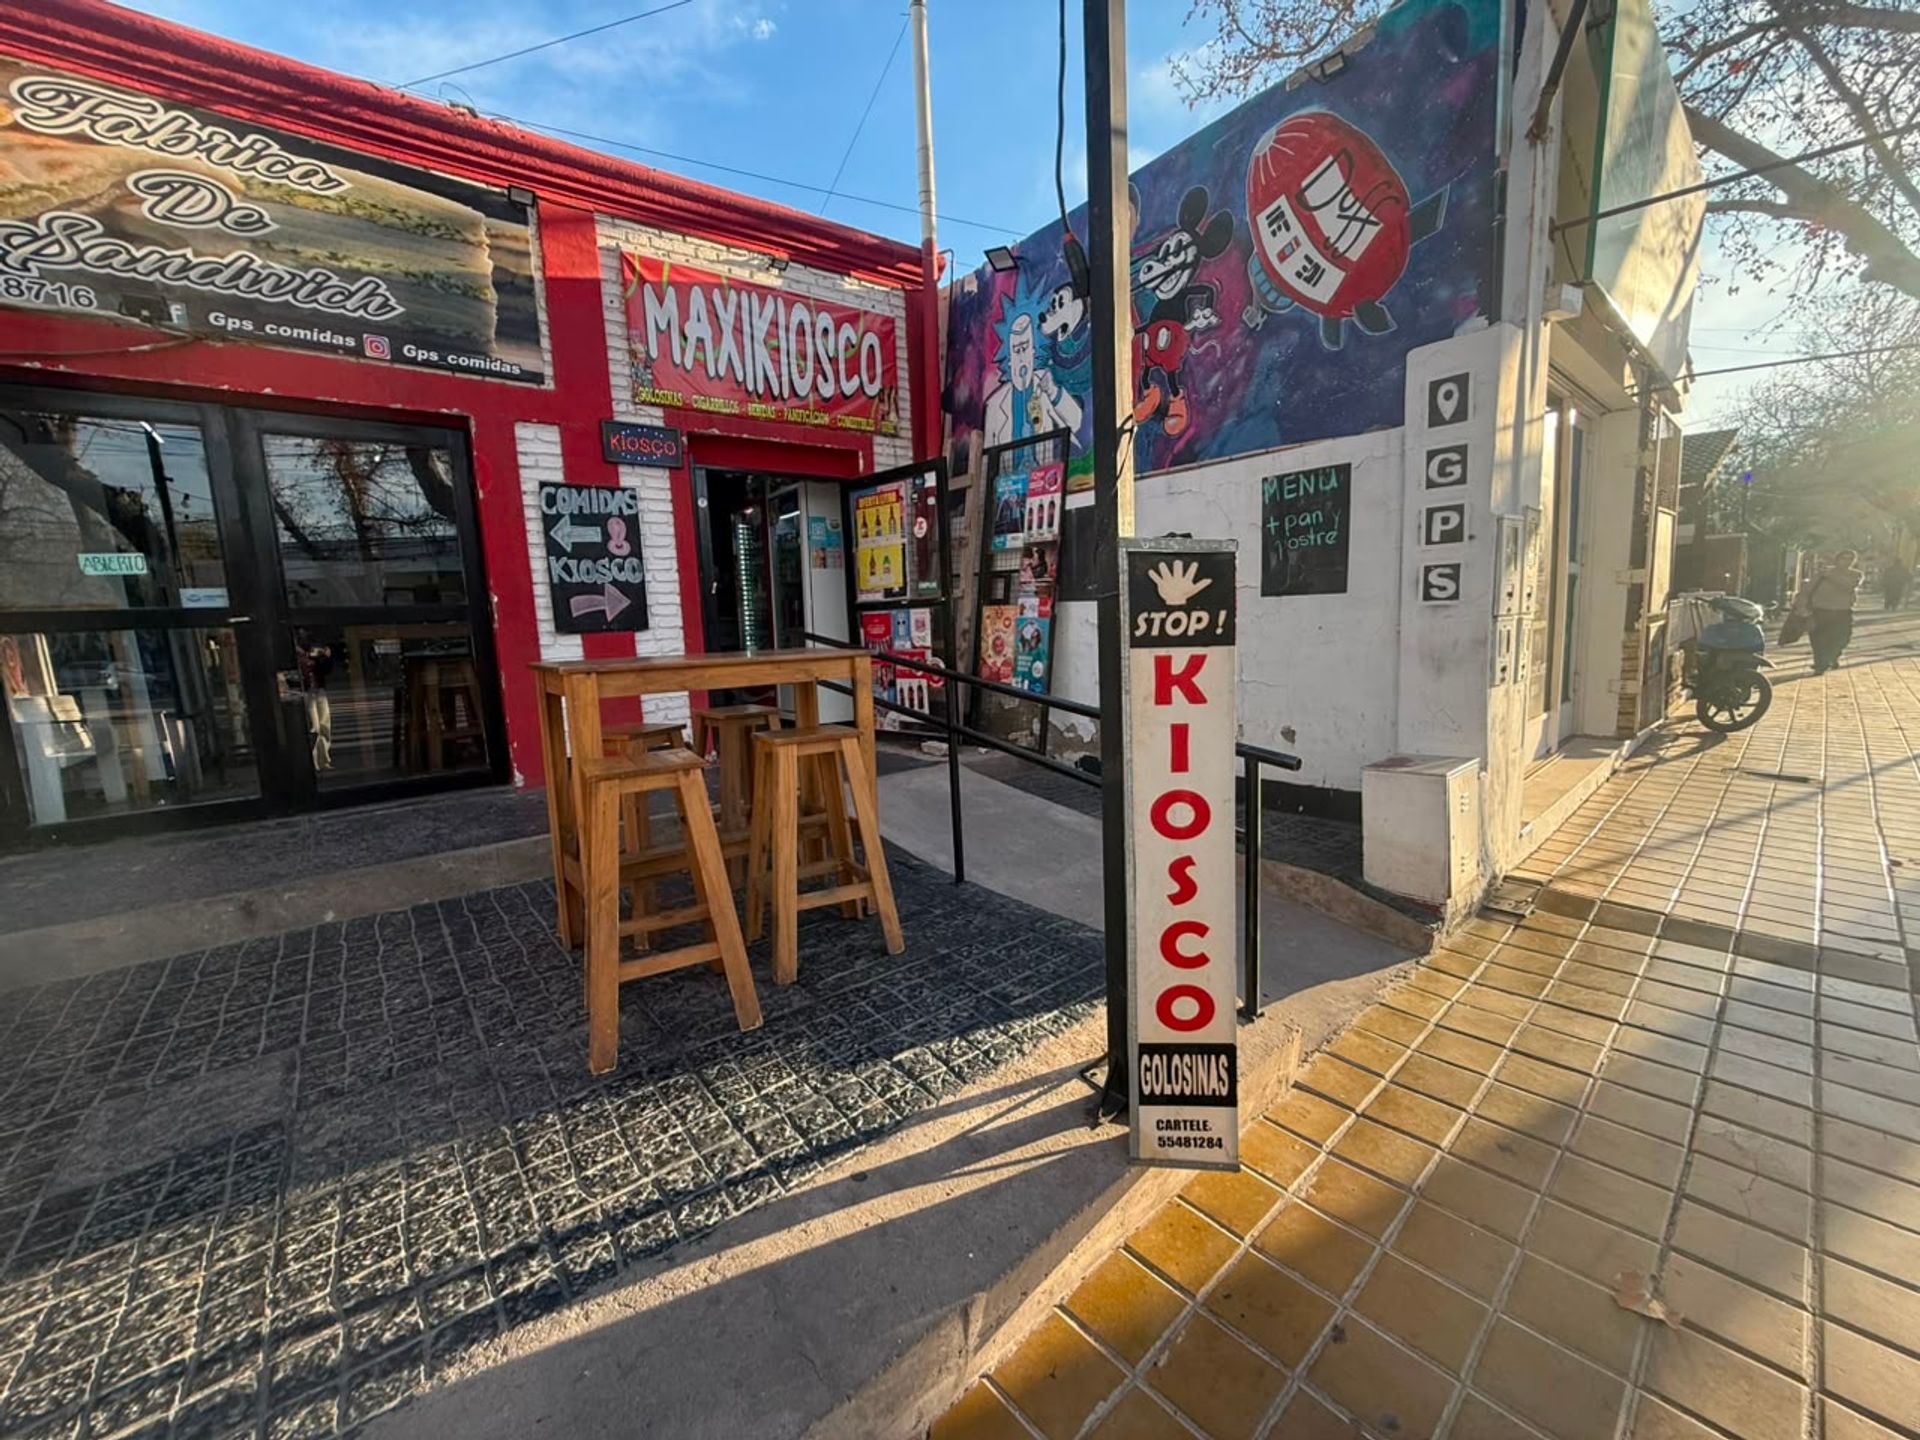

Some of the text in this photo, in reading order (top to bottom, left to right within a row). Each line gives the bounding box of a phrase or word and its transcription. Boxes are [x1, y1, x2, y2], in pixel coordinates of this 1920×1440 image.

[10, 76, 353, 194] Fabrica
[127, 169, 279, 236] De
[1296, 148, 1401, 259] Duff
[0, 211, 405, 320] Sandwich
[208, 311, 357, 349] Gps_comidas
[643, 282, 884, 400] MAXIKIOSCO
[402, 344, 522, 375] Gps_comidas
[540, 485, 639, 517] COMIDAS
[83, 554, 145, 573] ABIERTO
[549, 555, 645, 584] KIOSCO
[1150, 653, 1216, 1032] KIOSCO
[1141, 1053, 1229, 1096] GOLOSINAS
[1158, 1135, 1223, 1149] 55481284
